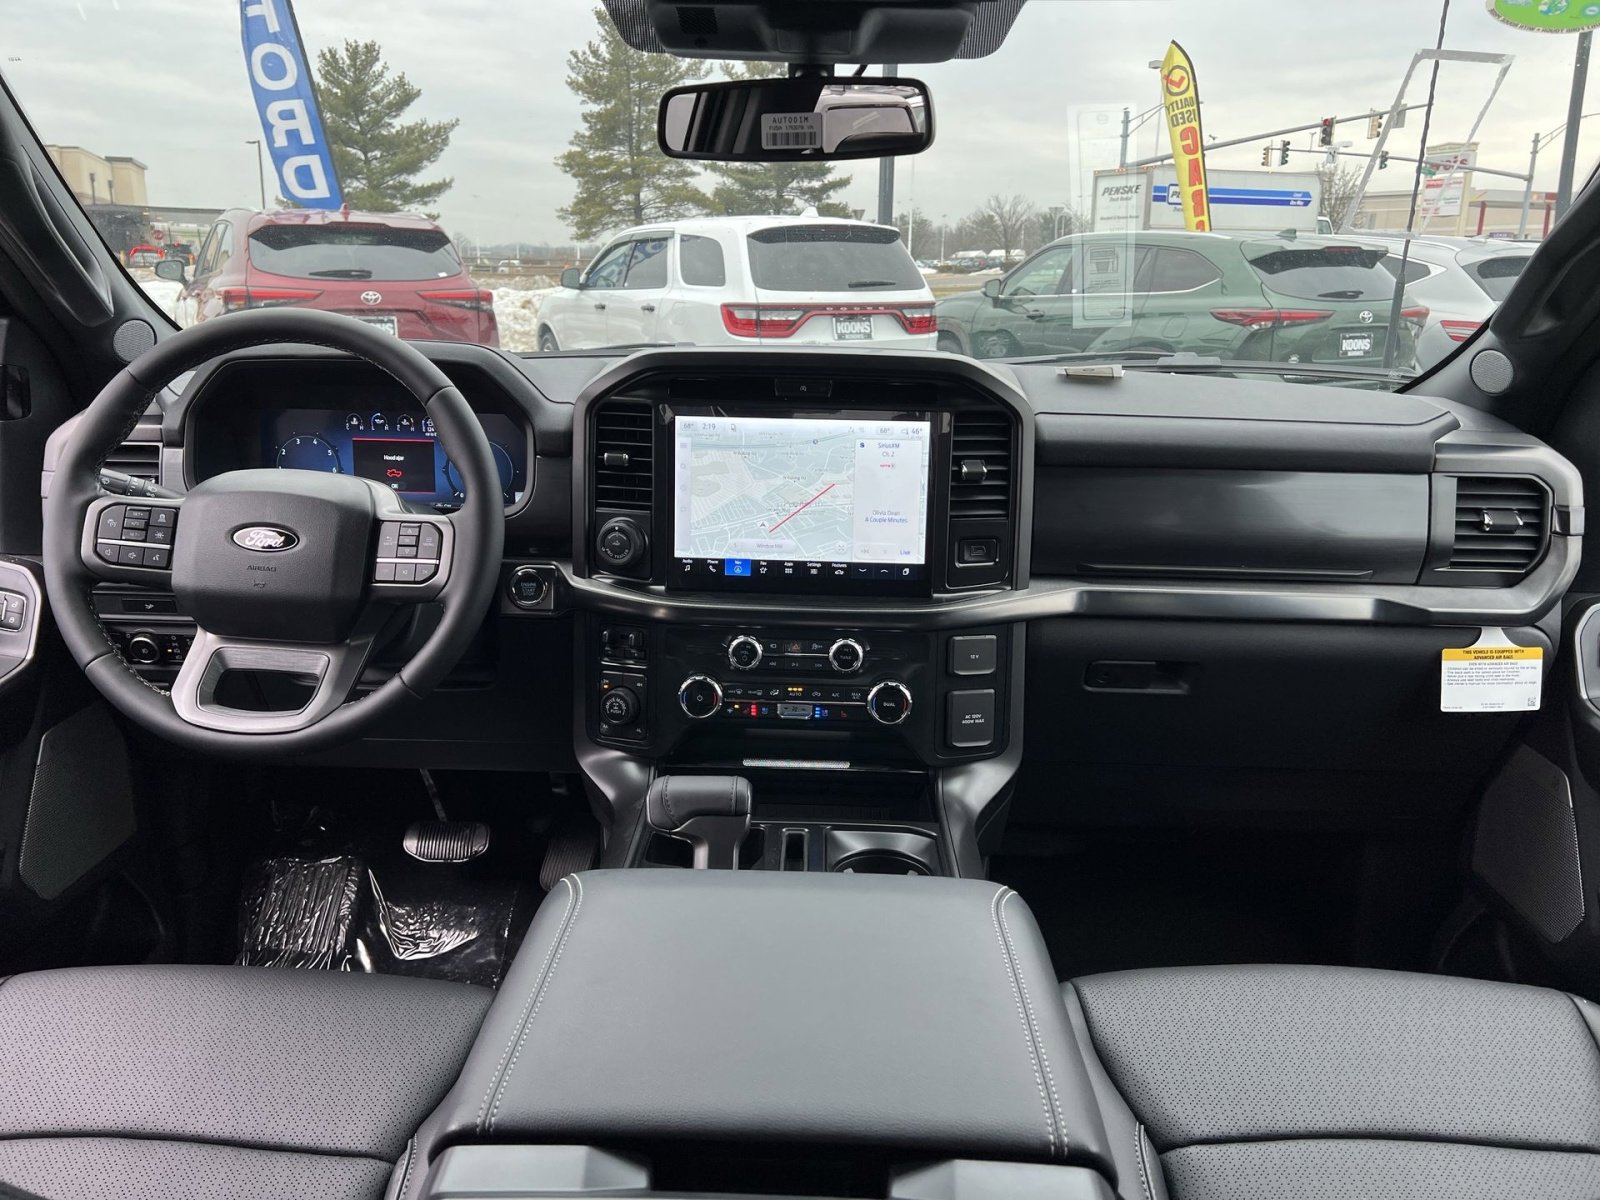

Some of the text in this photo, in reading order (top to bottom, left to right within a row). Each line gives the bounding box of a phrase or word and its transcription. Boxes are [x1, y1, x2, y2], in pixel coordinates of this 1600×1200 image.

[772, 115, 809, 124] AUTODIM
[1101, 184, 1142, 196] PENSKE
[837, 321, 871, 334] KOONS
[1342, 338, 1371, 351] KOONS
[702, 422, 716, 430] 2:19
[870, 516, 887, 524] Couple
[245, 529, 285, 548] Ford
[246, 564, 277, 572] AIRBAG
